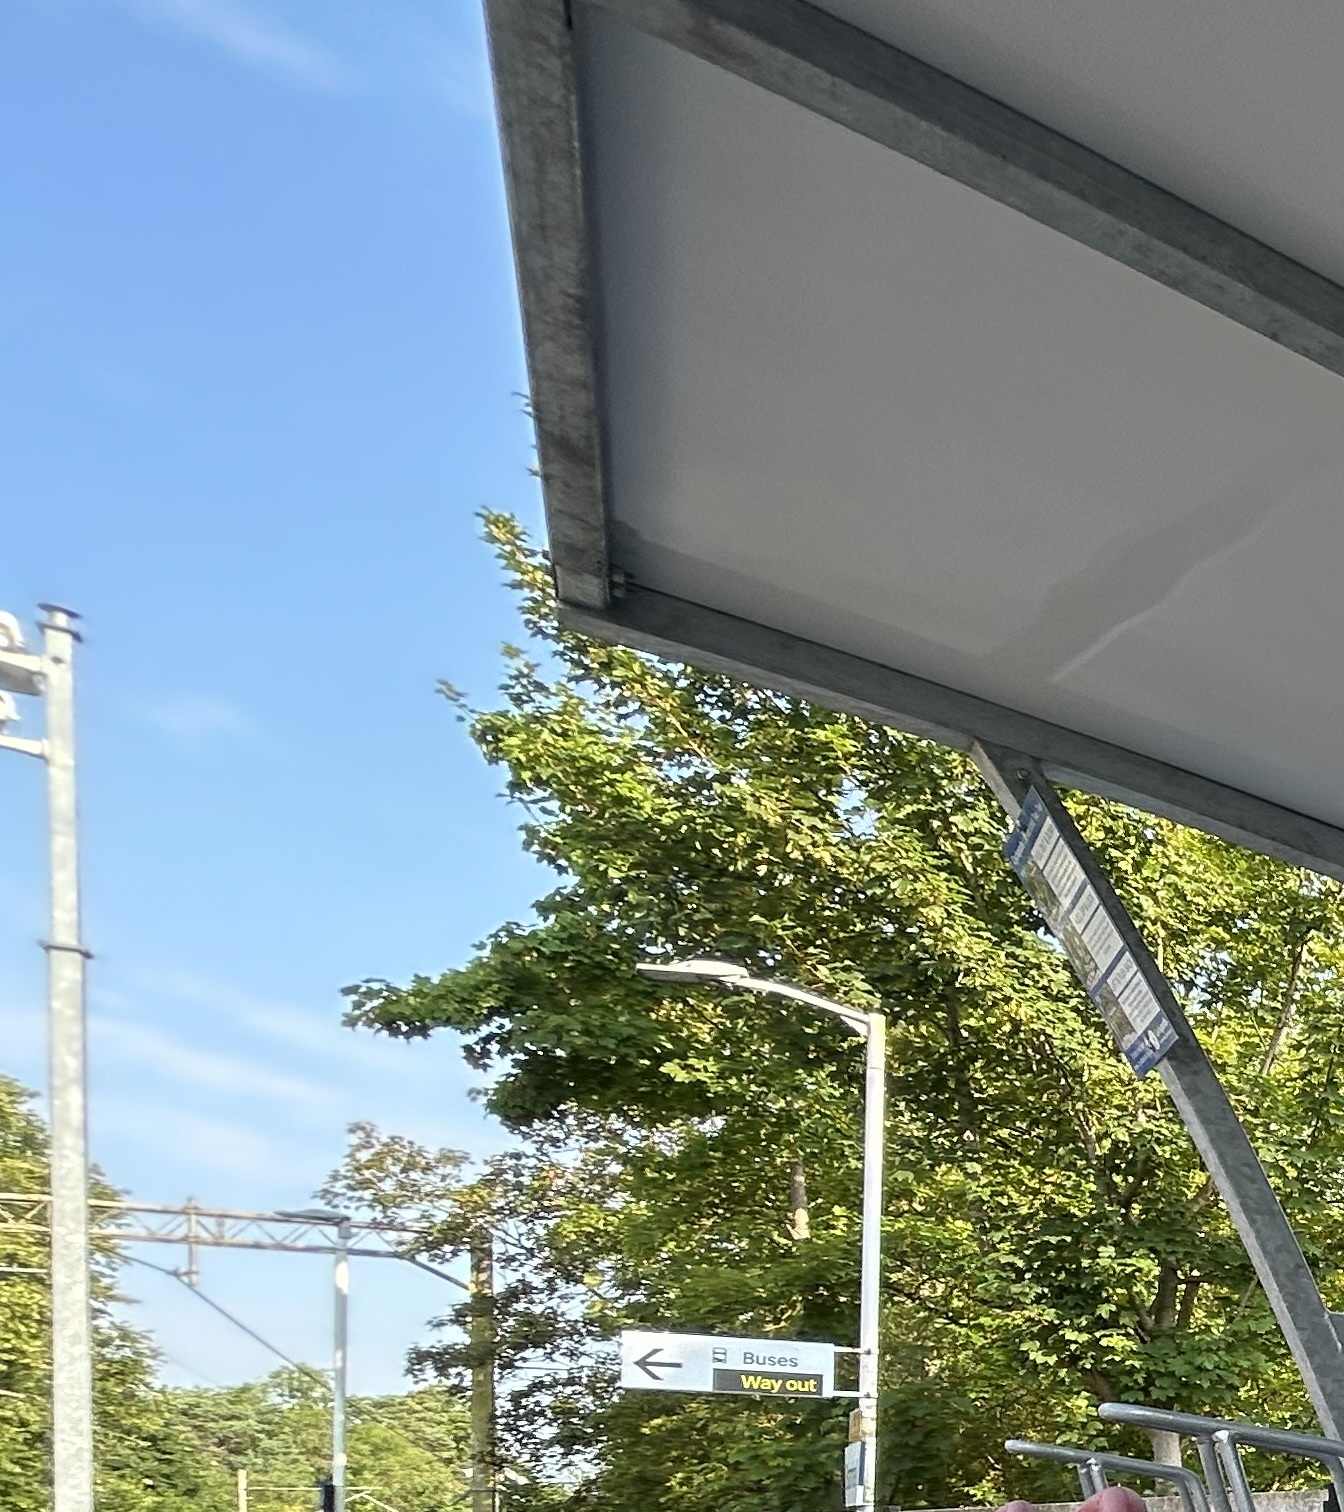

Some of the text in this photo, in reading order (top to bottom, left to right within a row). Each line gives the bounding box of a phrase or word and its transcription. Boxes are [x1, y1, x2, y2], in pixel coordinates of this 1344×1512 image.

[742, 1351, 799, 1368] Buses
[740, 1374, 818, 1394] Way out
